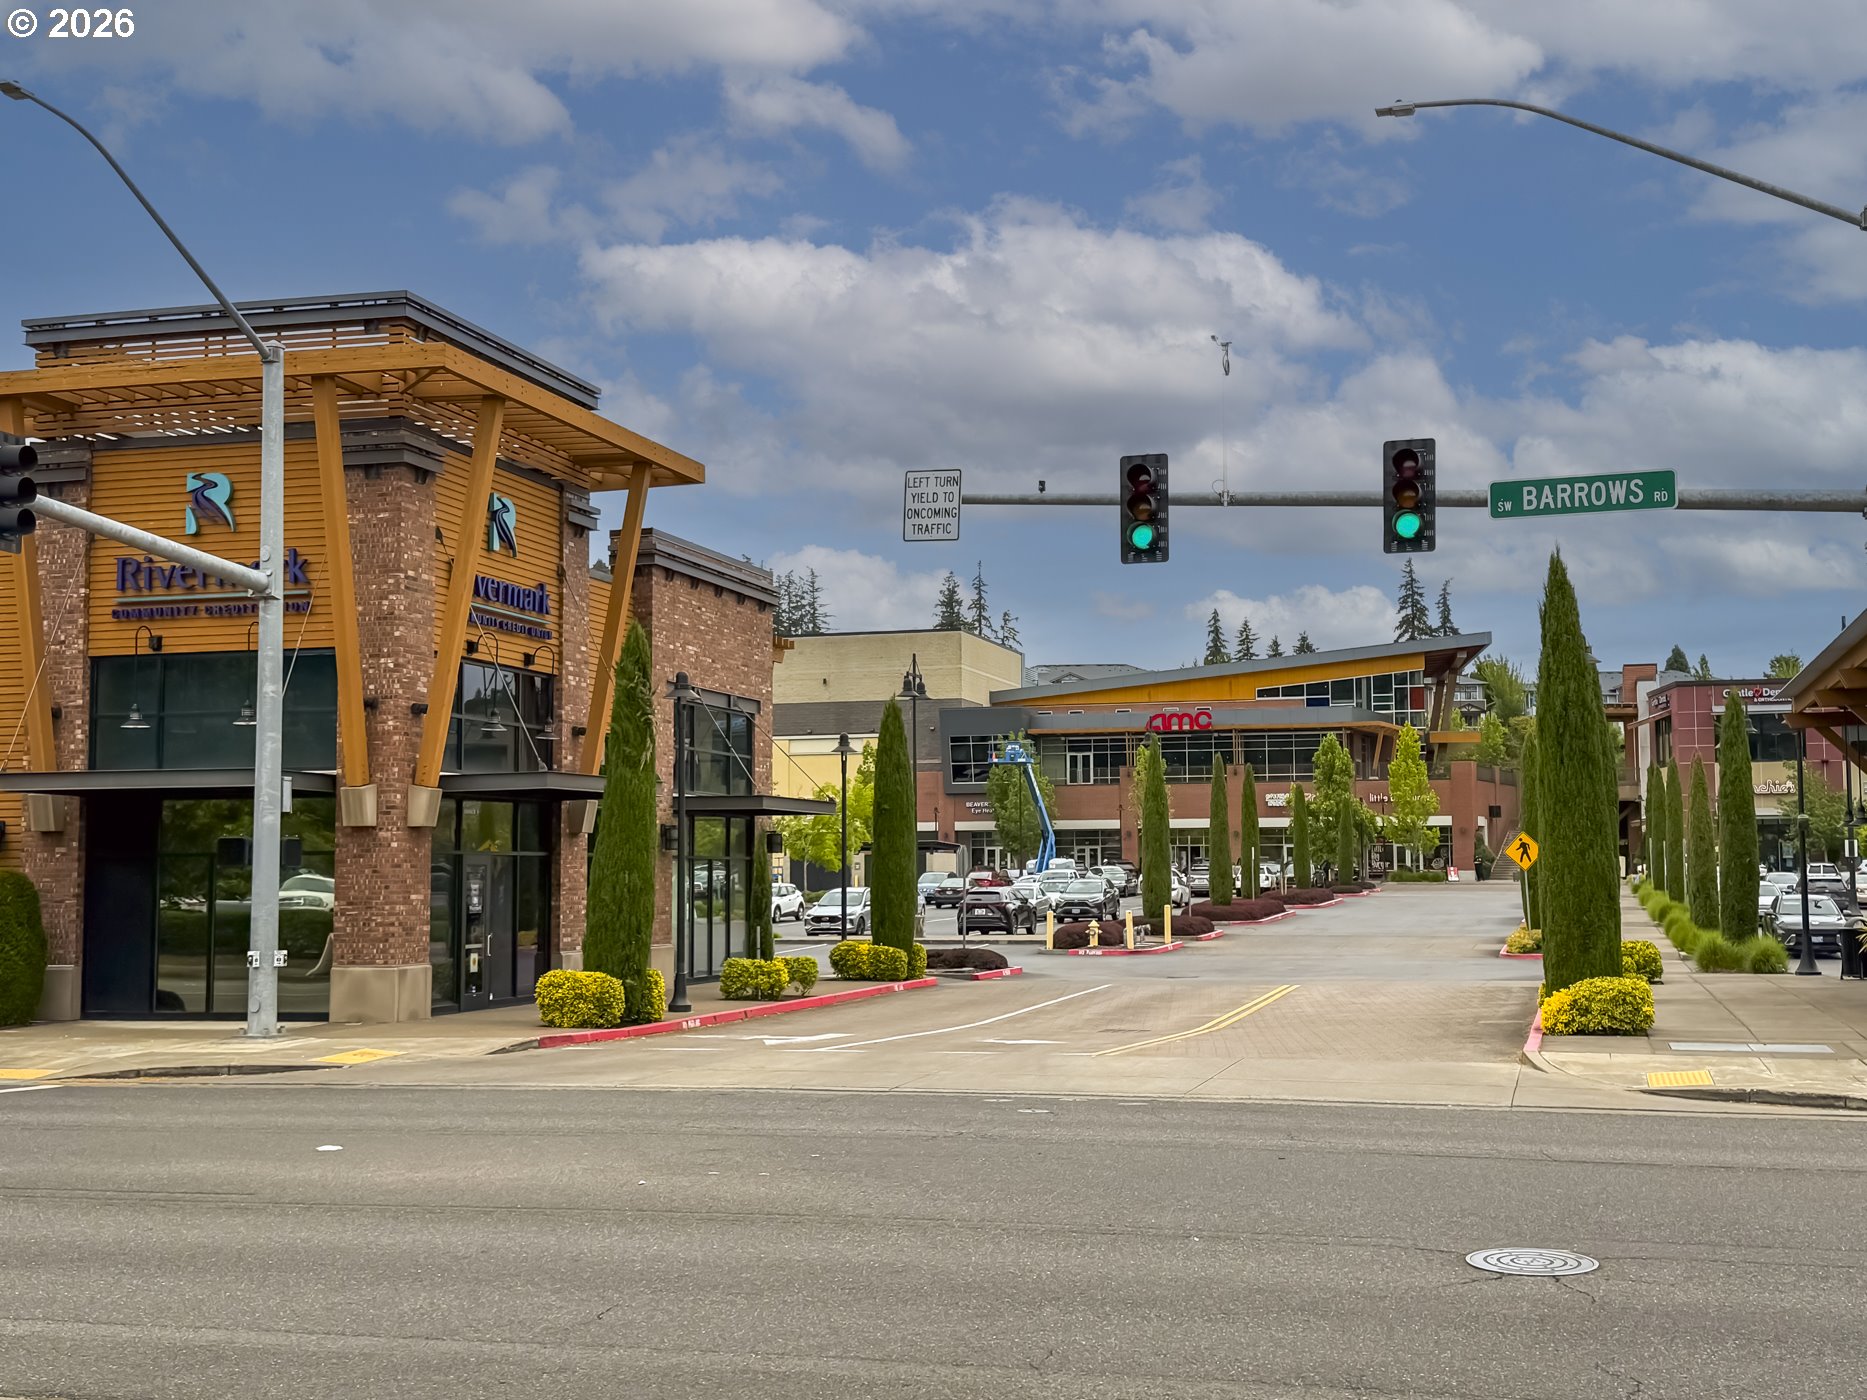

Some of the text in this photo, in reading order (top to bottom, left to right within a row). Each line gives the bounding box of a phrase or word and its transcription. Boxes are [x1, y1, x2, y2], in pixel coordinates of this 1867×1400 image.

[907, 475, 959, 488] LEFT TURN
[911, 491, 955, 504] YIELD TO
[1497, 478, 1669, 513] SW BARROWS RD
[906, 506, 958, 520] ONCOMING
[911, 522, 952, 535] TRAFFIC
[1145, 711, 1213, 731] amc
